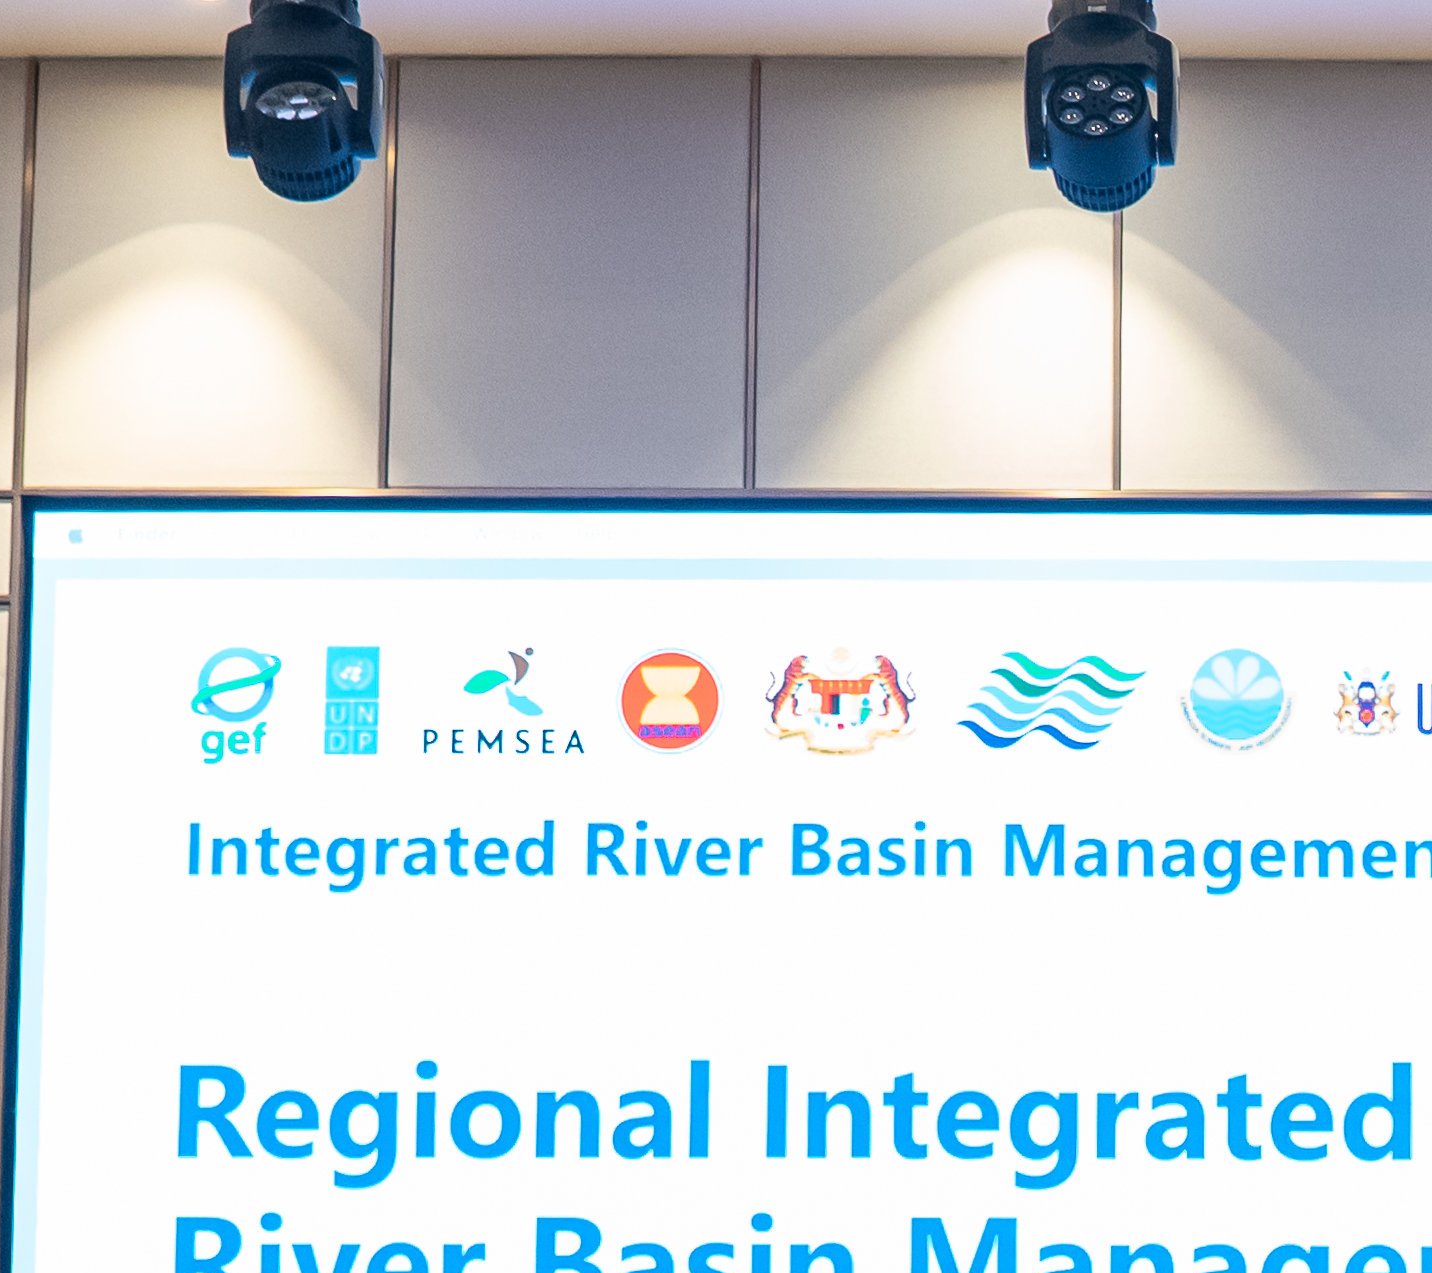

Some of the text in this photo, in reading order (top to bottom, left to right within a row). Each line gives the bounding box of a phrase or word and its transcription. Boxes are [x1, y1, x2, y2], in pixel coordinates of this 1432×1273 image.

[201, 722, 267, 764] gef
[423, 729, 584, 754] PEMSEA
[188, 819, 555, 894] Integrated
[586, 820, 764, 877] River
[791, 821, 972, 877] Basin
[177, 1059, 1413, 1191] Regional Integrated
